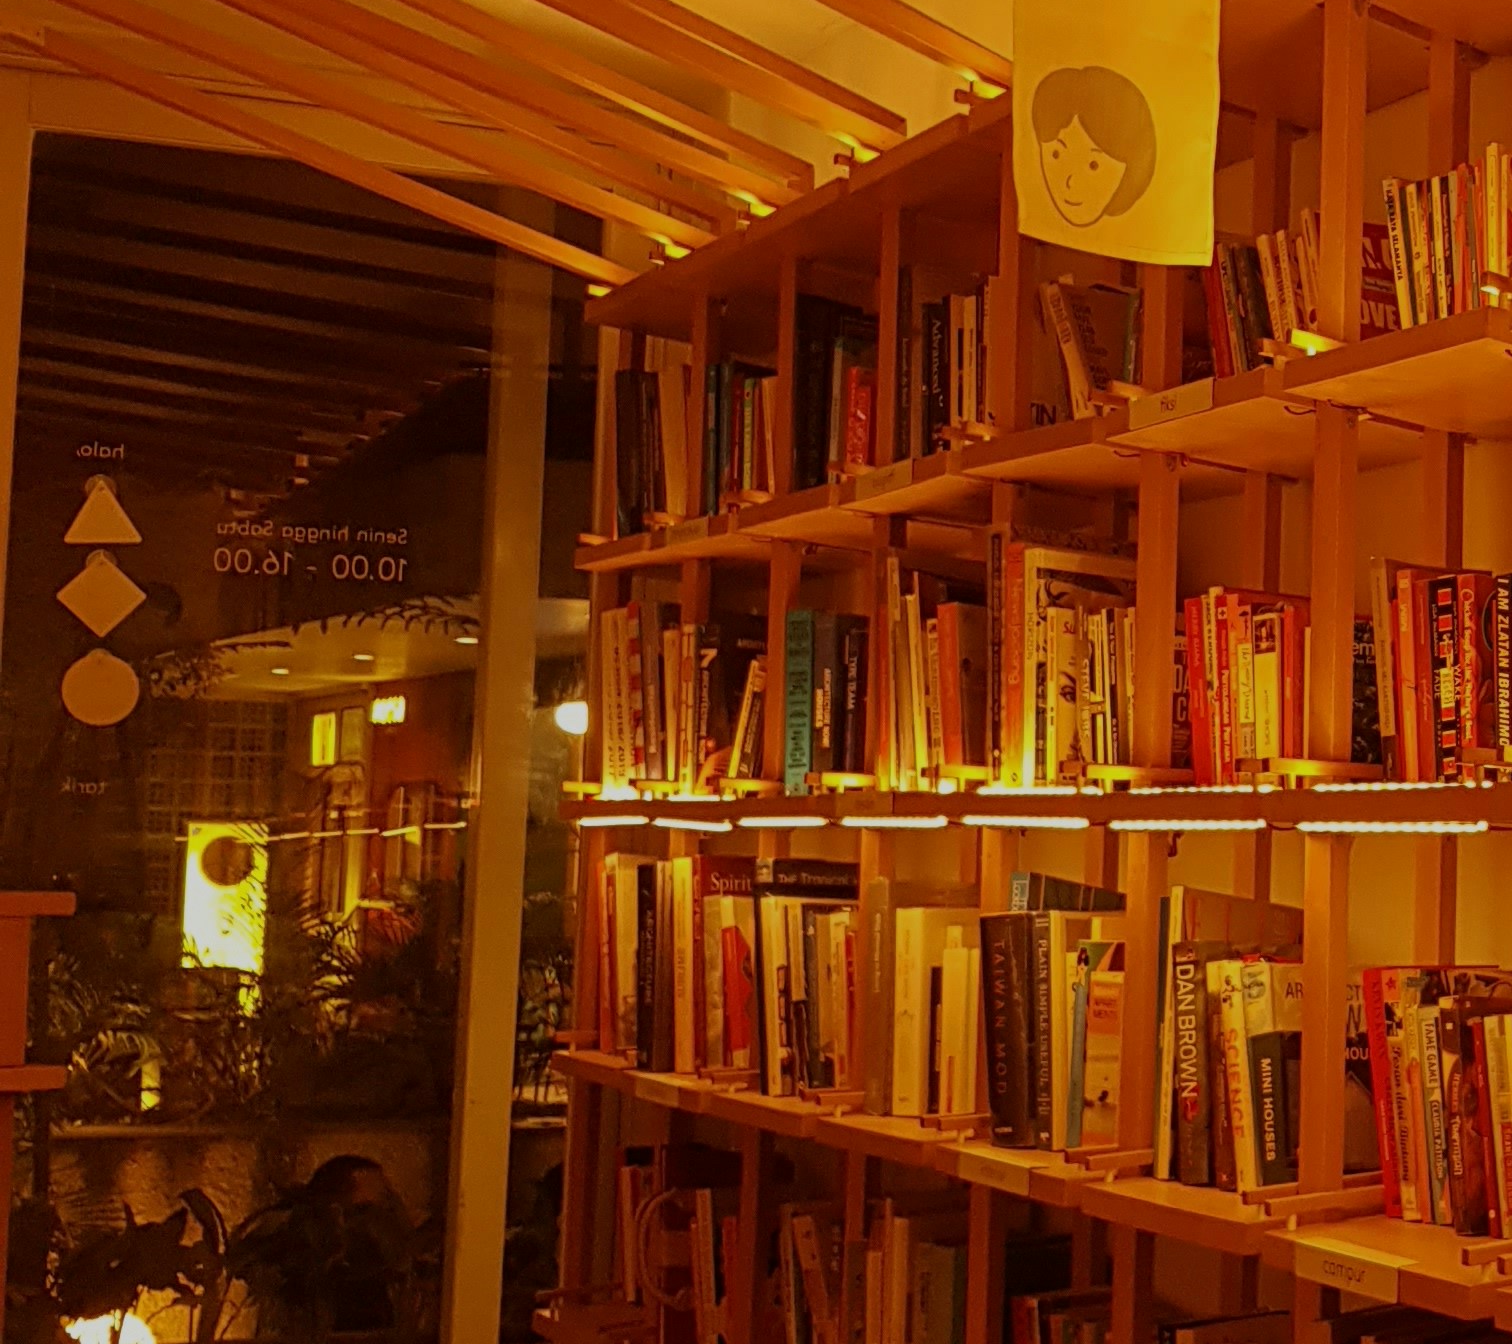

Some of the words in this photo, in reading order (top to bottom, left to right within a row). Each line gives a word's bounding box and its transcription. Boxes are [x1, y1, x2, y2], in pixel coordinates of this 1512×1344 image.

[1498, 587, 1508, 606] AM
[1498, 613, 1509, 667] ZLATAN
[1433, 669, 1441, 699] FADE
[1453, 664, 1461, 699] WAKE
[1038, 939, 1048, 980] PLAIN
[992, 940, 1007, 1028] TAIWAN
[1176, 965, 1195, 1008] DAN
[1178, 1016, 1199, 1097] BROWN
[1260, 1057, 1273, 1097] MINI
[1427, 1054, 1438, 1085] GAME
[1225, 1027, 1245, 1139] SCIENCE
[1264, 1101, 1277, 1161] HOUSES
